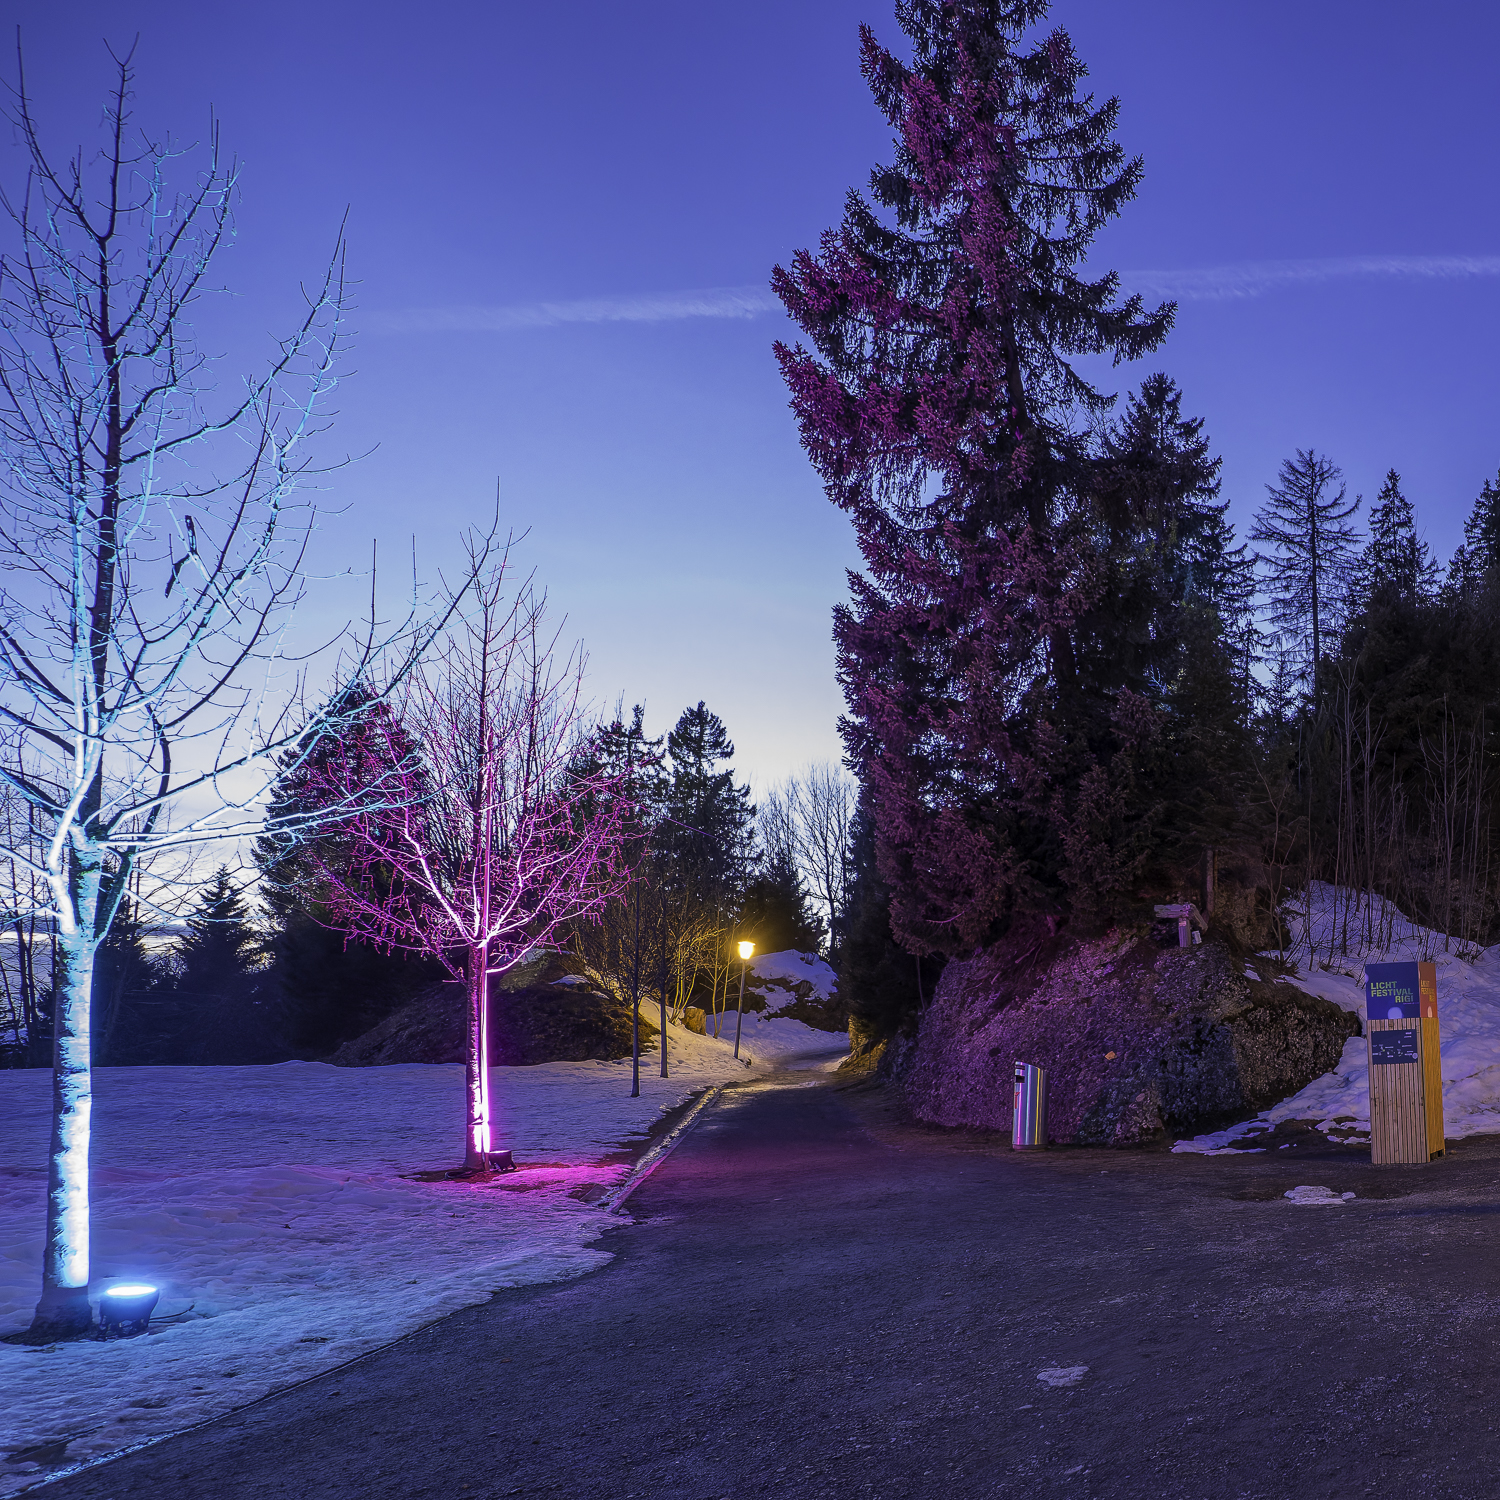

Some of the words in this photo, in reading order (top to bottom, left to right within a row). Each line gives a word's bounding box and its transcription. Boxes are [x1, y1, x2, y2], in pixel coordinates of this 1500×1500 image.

[1370, 981, 1397, 990] LICHT
[1371, 988, 1413, 998] FESTIVAL
[1395, 995, 1414, 1003] RIGI
